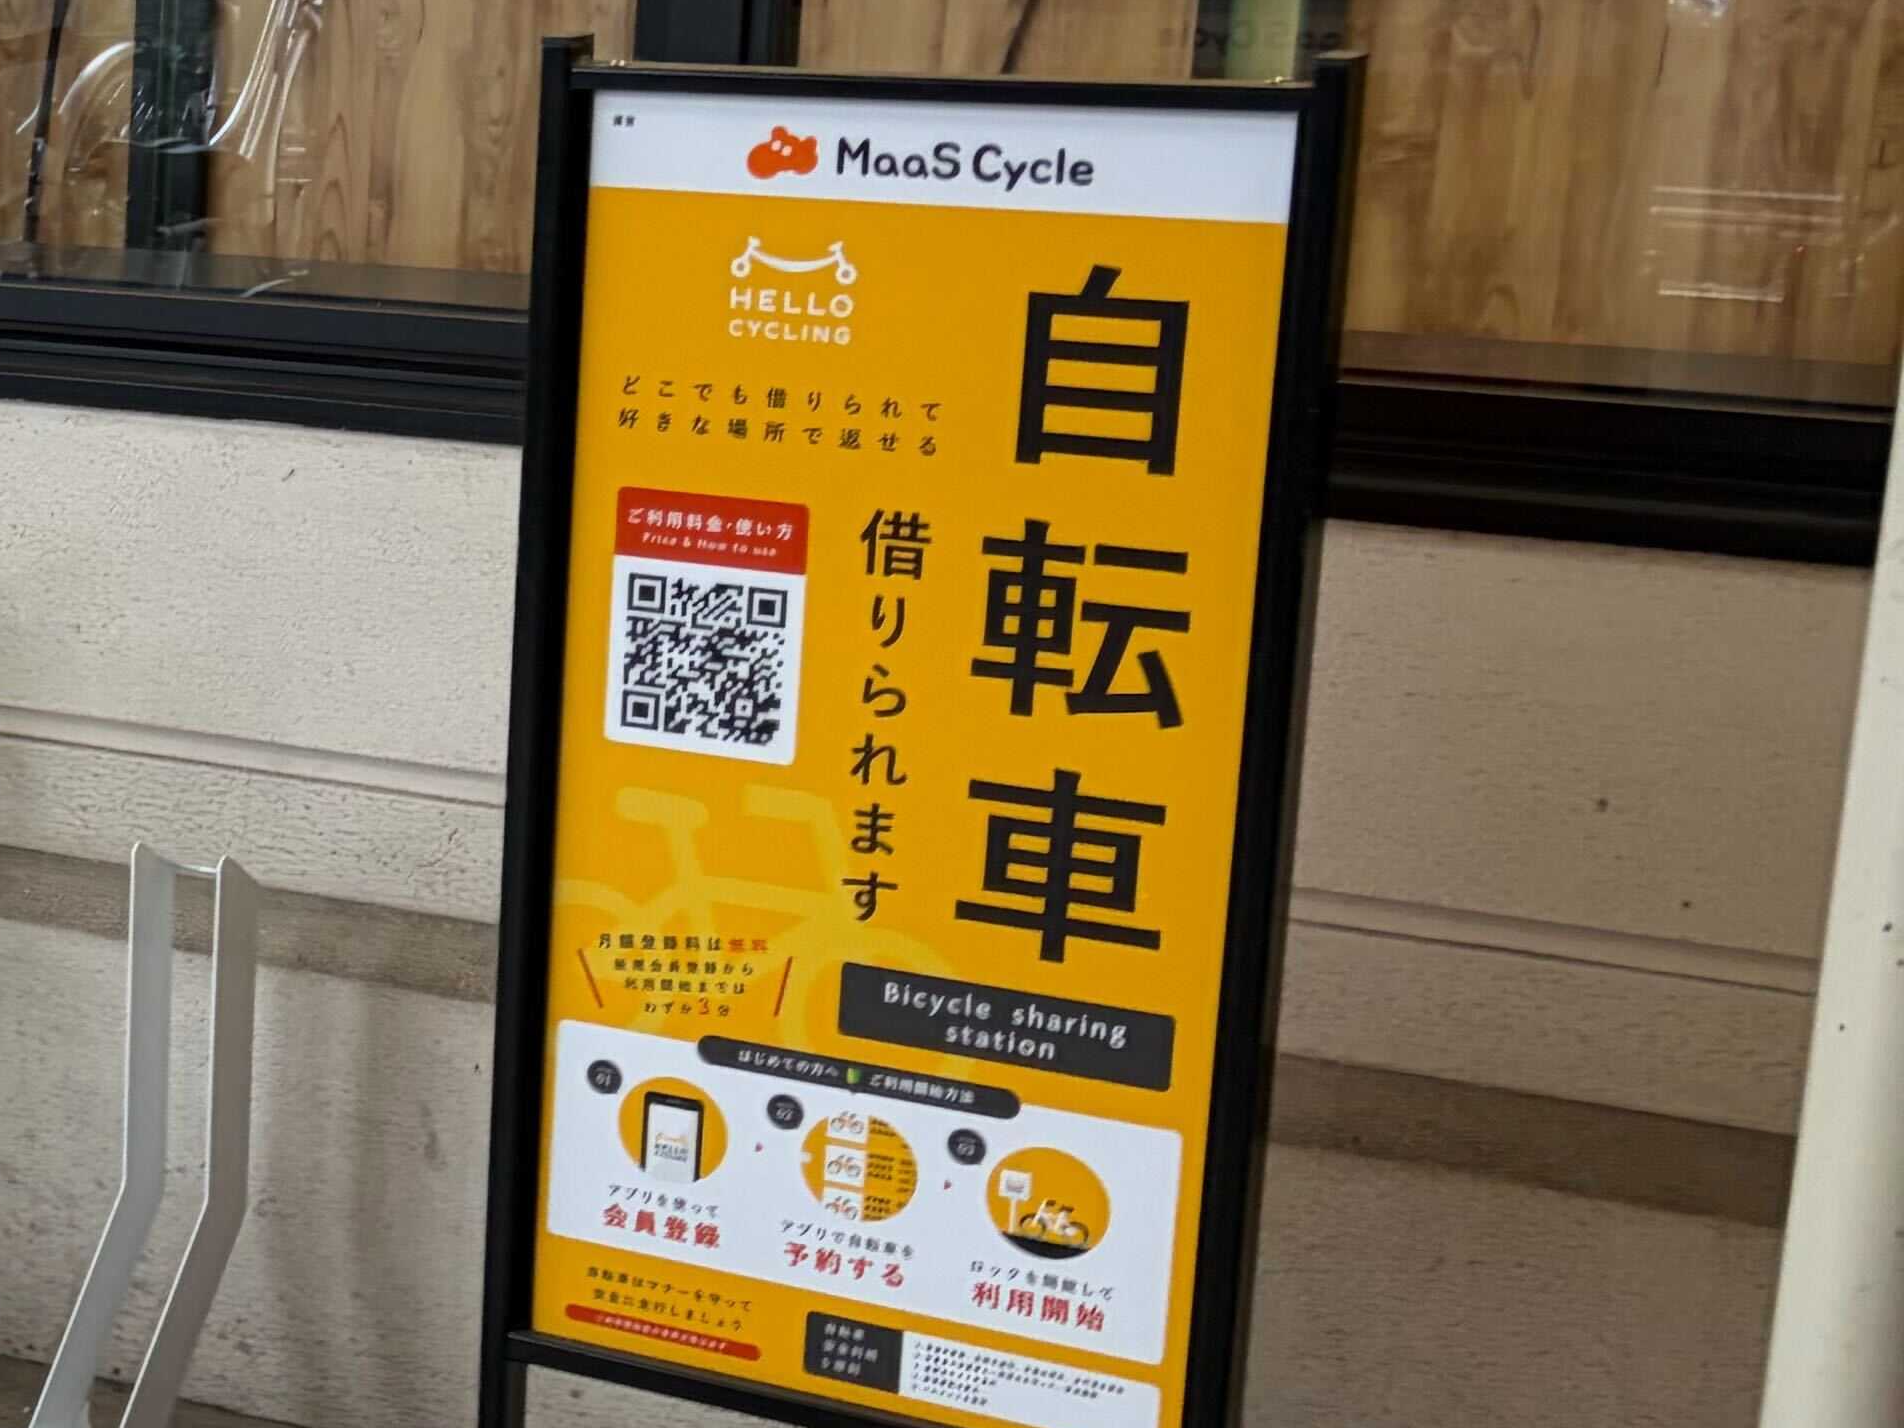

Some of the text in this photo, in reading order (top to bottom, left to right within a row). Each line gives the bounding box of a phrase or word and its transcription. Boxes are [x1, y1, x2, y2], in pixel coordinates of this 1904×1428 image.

[835, 136, 1095, 191] MaaS Cycle
[730, 287, 854, 318] HELLO
[728, 319, 852, 346] CYCLING
[622, 375, 943, 424] どこでも借りられて
[618, 408, 937, 456] 好きな場所で返せる
[627, 508, 794, 541] ご利用料金・使い方
[954, 265, 1191, 963] 自転車
[842, 508, 932, 924] 借りられます
[884, 982, 1127, 1049] Bicycle sharing
[945, 1025, 1055, 1060] station
[602, 1204, 721, 1249] 会員登録
[783, 1242, 905, 1288] 予約する
[971, 1282, 1105, 1332] 利用開始
